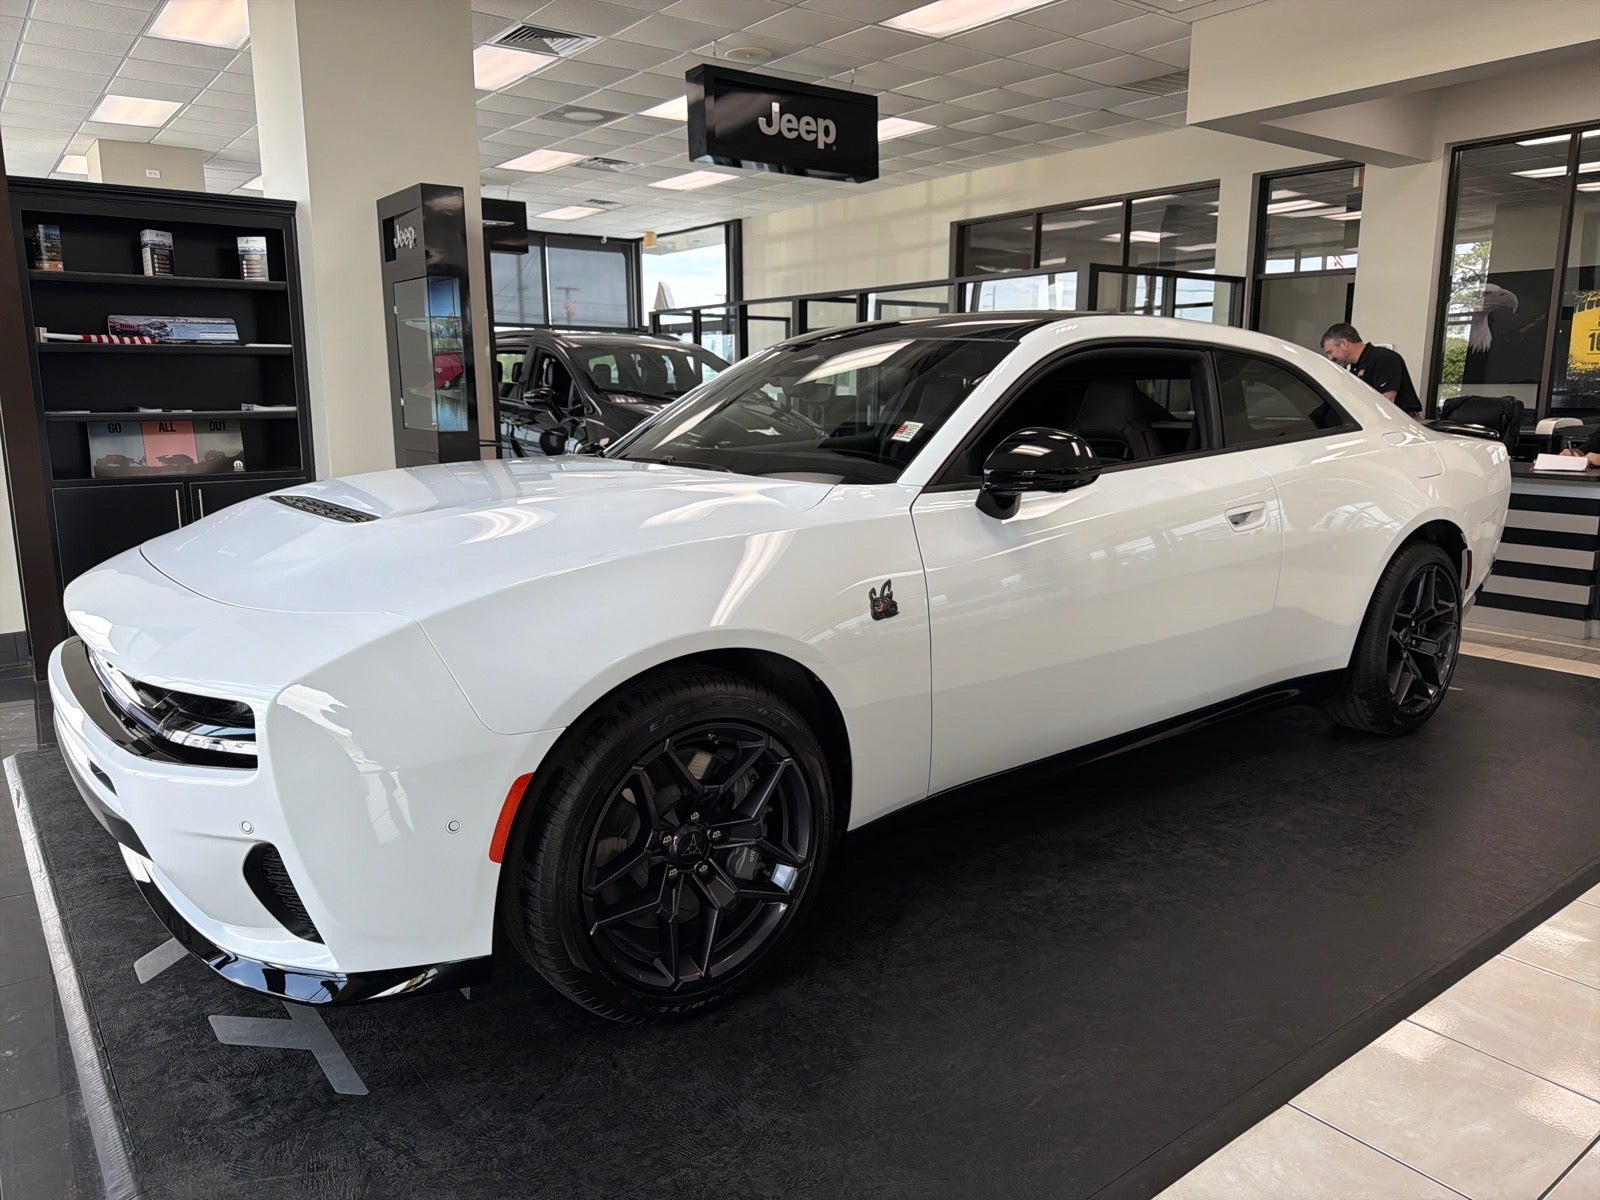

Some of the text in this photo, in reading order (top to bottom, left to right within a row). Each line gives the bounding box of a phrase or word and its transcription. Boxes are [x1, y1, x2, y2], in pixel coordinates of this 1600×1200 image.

[758, 101, 837, 150] Jeep
[393, 224, 415, 249] Jeep
[108, 421, 226, 433] GO ALL OUT
